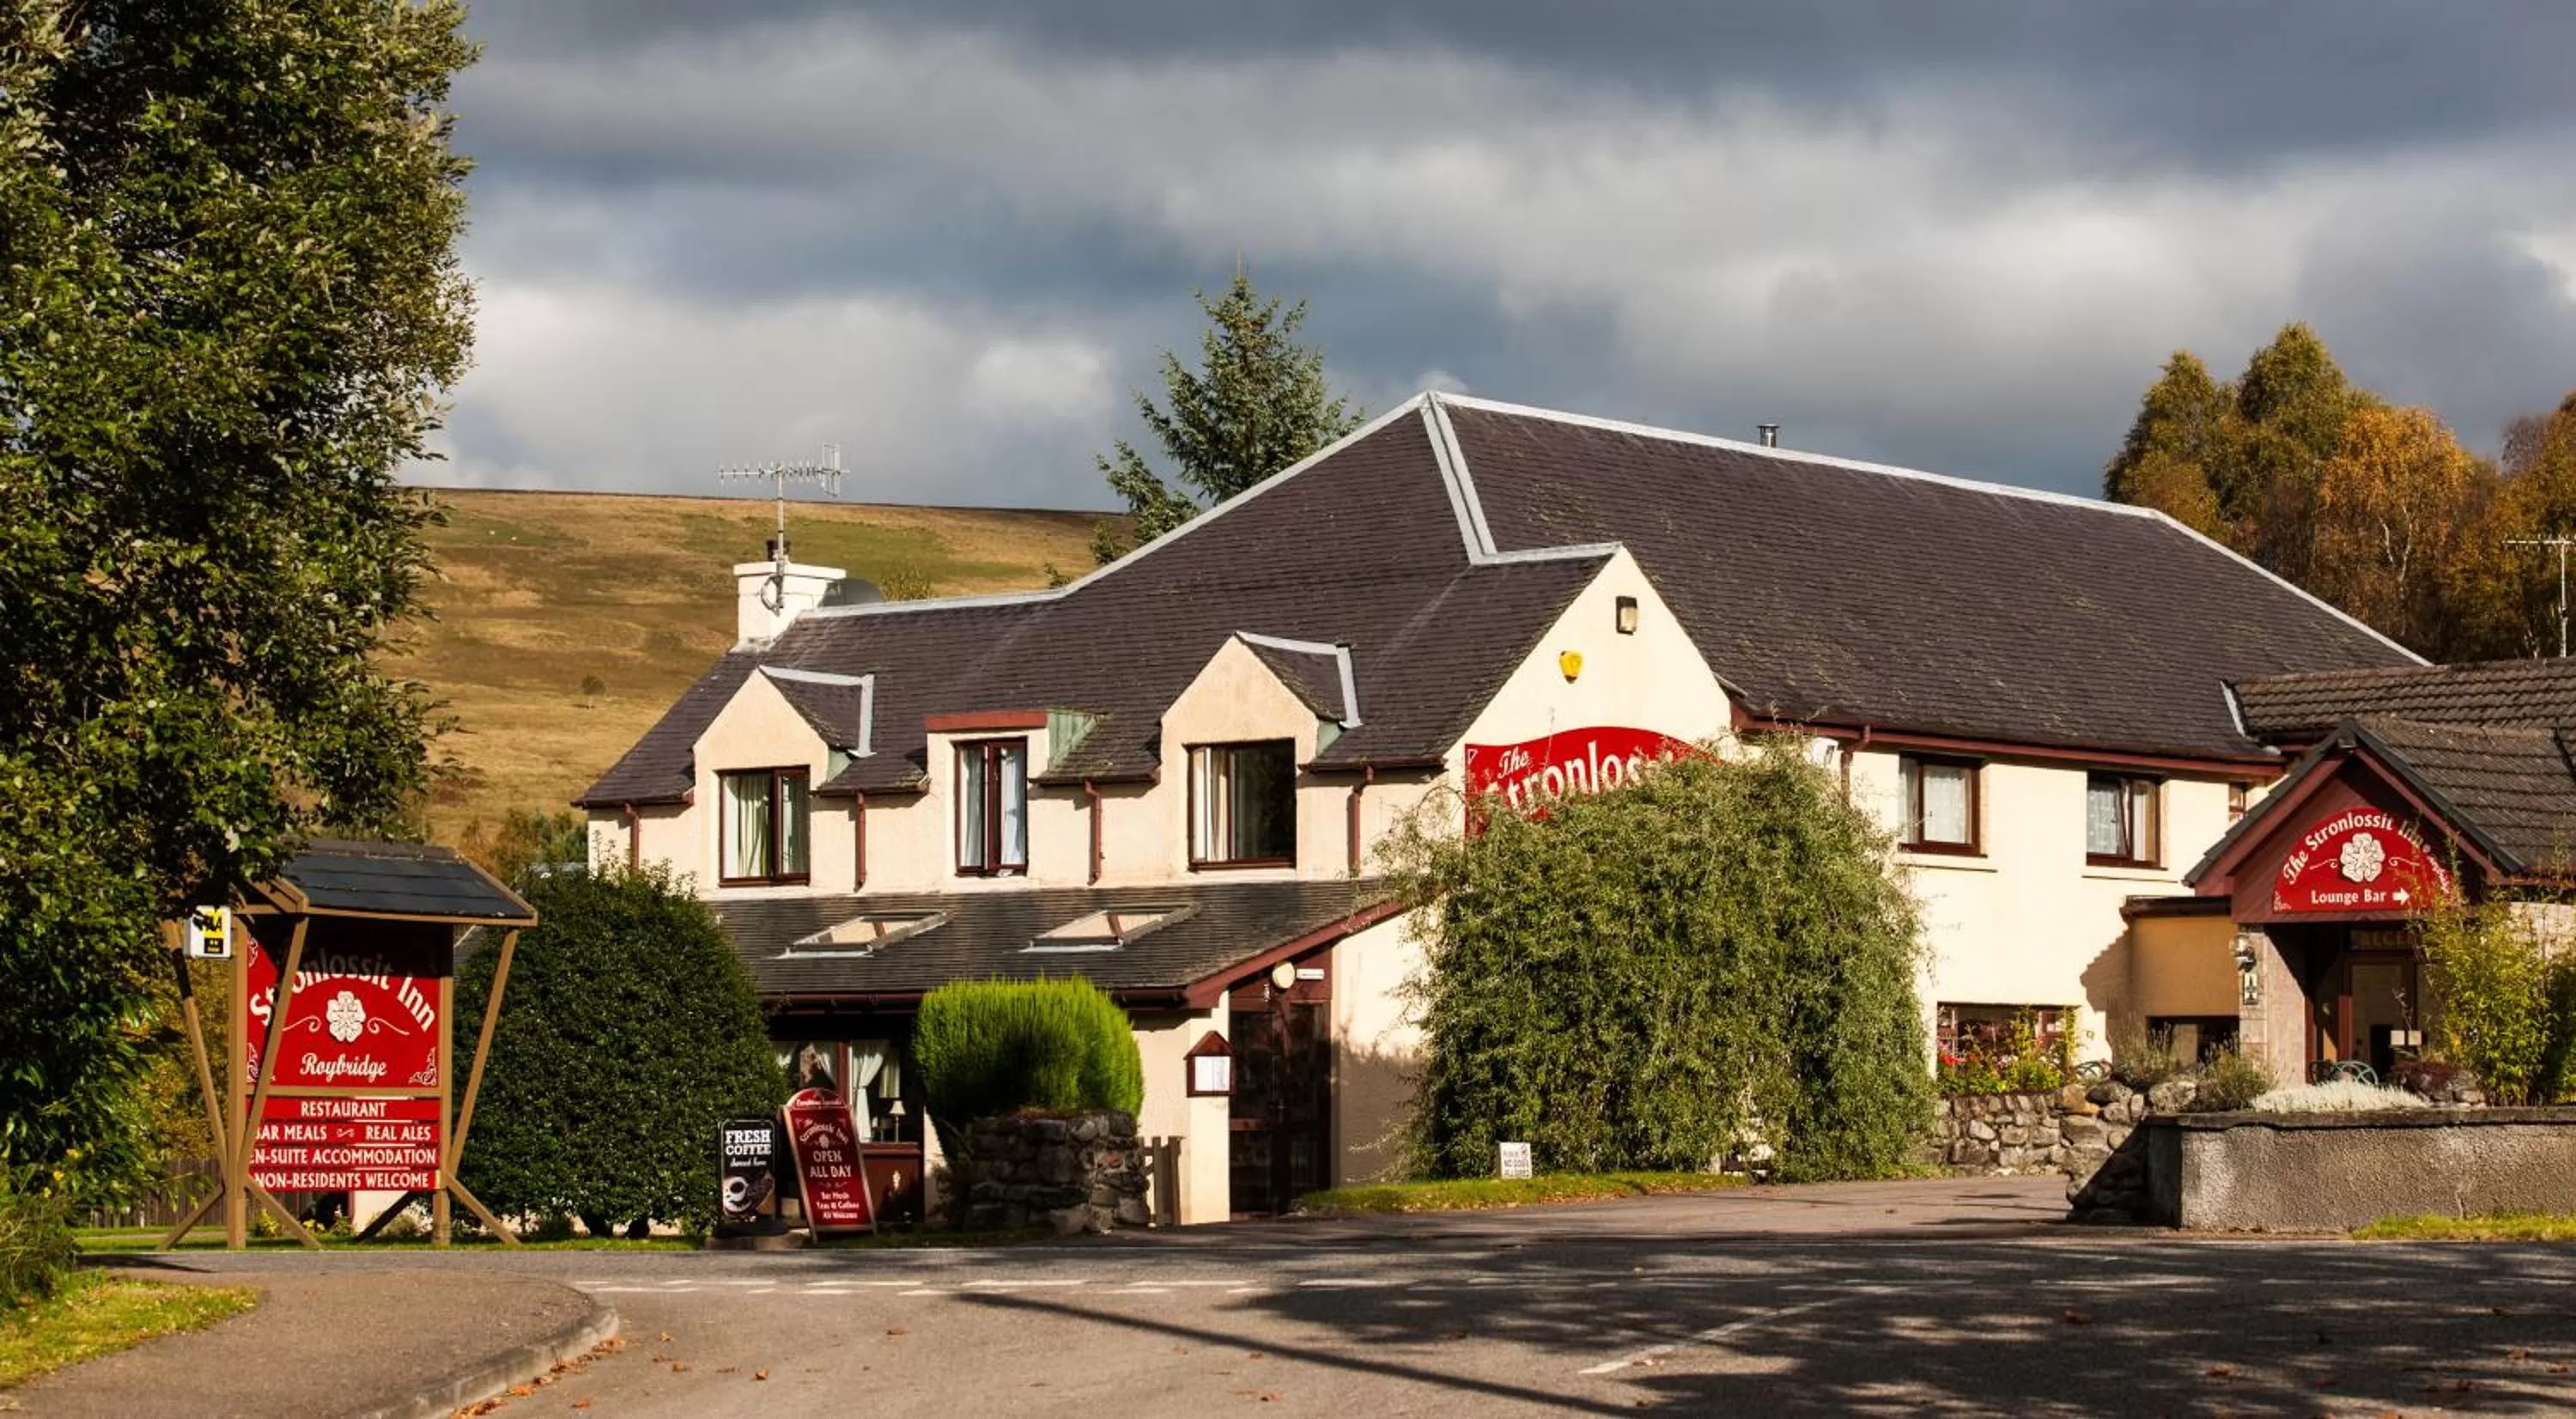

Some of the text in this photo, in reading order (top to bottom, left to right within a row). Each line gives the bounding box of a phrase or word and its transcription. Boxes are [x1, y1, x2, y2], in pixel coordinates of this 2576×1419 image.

[1498, 746, 1528, 779] The
[2283, 850, 2309, 886] The
[2306, 812, 2393, 851] Stronlossit
[2311, 888, 2387, 905] Lounge Bar
[250, 947, 435, 1032] Stonlossit Inn
[301, 1052, 387, 1083] Roybridge
[301, 1101, 386, 1118] RESTAURANT
[283, 1125, 327, 1141] MEALS
[365, 1126, 397, 1141] REAL
[400, 1126, 431, 1141] ALES
[725, 1130, 772, 1143] FRESH
[312, 1148, 437, 1165] ACCOMMODATION
[725, 1143, 772, 1155] COFFEE
[812, 1150, 842, 1162] OPEN
[810, 1165, 852, 1178] ALL DAY
[255, 1172, 428, 1189] NON-RESIDENTS WELCOME
